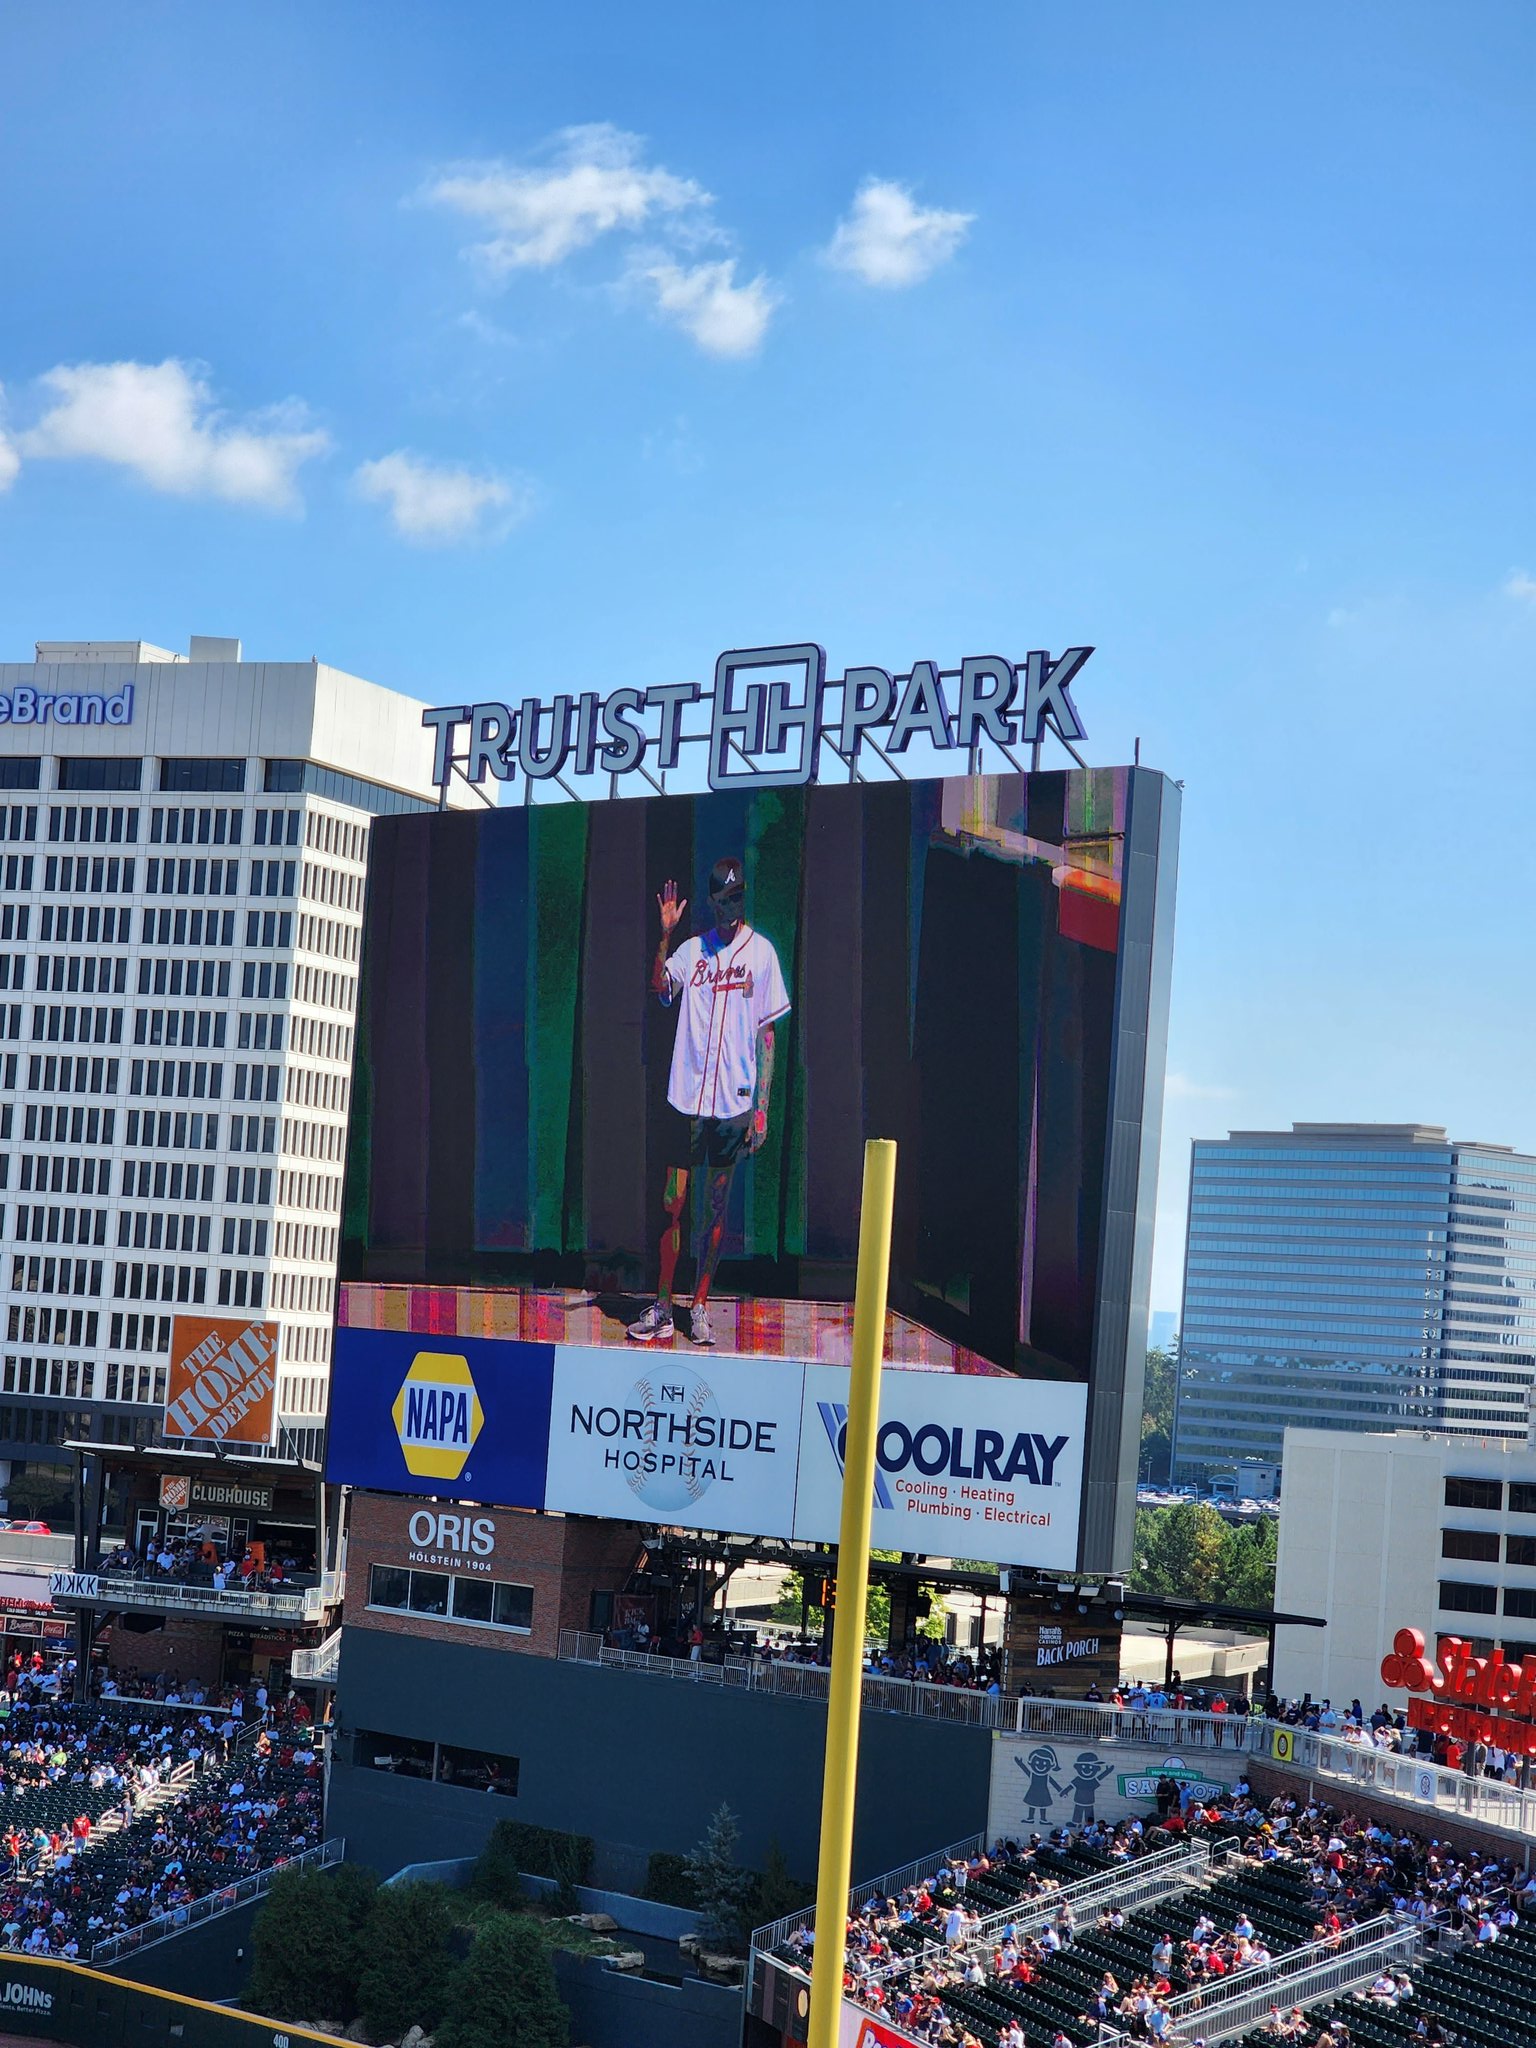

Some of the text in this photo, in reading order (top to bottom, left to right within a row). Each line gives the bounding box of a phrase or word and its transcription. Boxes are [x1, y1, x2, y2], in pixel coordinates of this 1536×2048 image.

[422, 646, 1096, 786] TRUIST PARK
[180, 1330, 226, 1377] THE
[166, 1320, 277, 1437] HOME
[206, 1366, 275, 1439] DEPOT
[407, 1387, 468, 1444] NAPA
[570, 1404, 777, 1453] NORTHSIDE
[604, 1449, 734, 1481] HOSPITAL
[838, 1421, 1070, 1487] OOLRAY
[162, 1478, 188, 1505] HOME
[192, 1485, 268, 1506] CLUBHOUSE
[895, 1479, 1015, 1506] Cooling Heating
[907, 1499, 1051, 1526] Plumbing Electrical
[409, 1510, 495, 1556] ORIS
[409, 1551, 492, 1572] HÖLSTEIN 1904
[250, 1632, 287, 1642] BREADSTICKS
[1037, 1638, 1099, 1667] BACK PORCH
[1127, 1779, 1221, 1801] SAOT
[273, 2033, 290, 2048] 400
